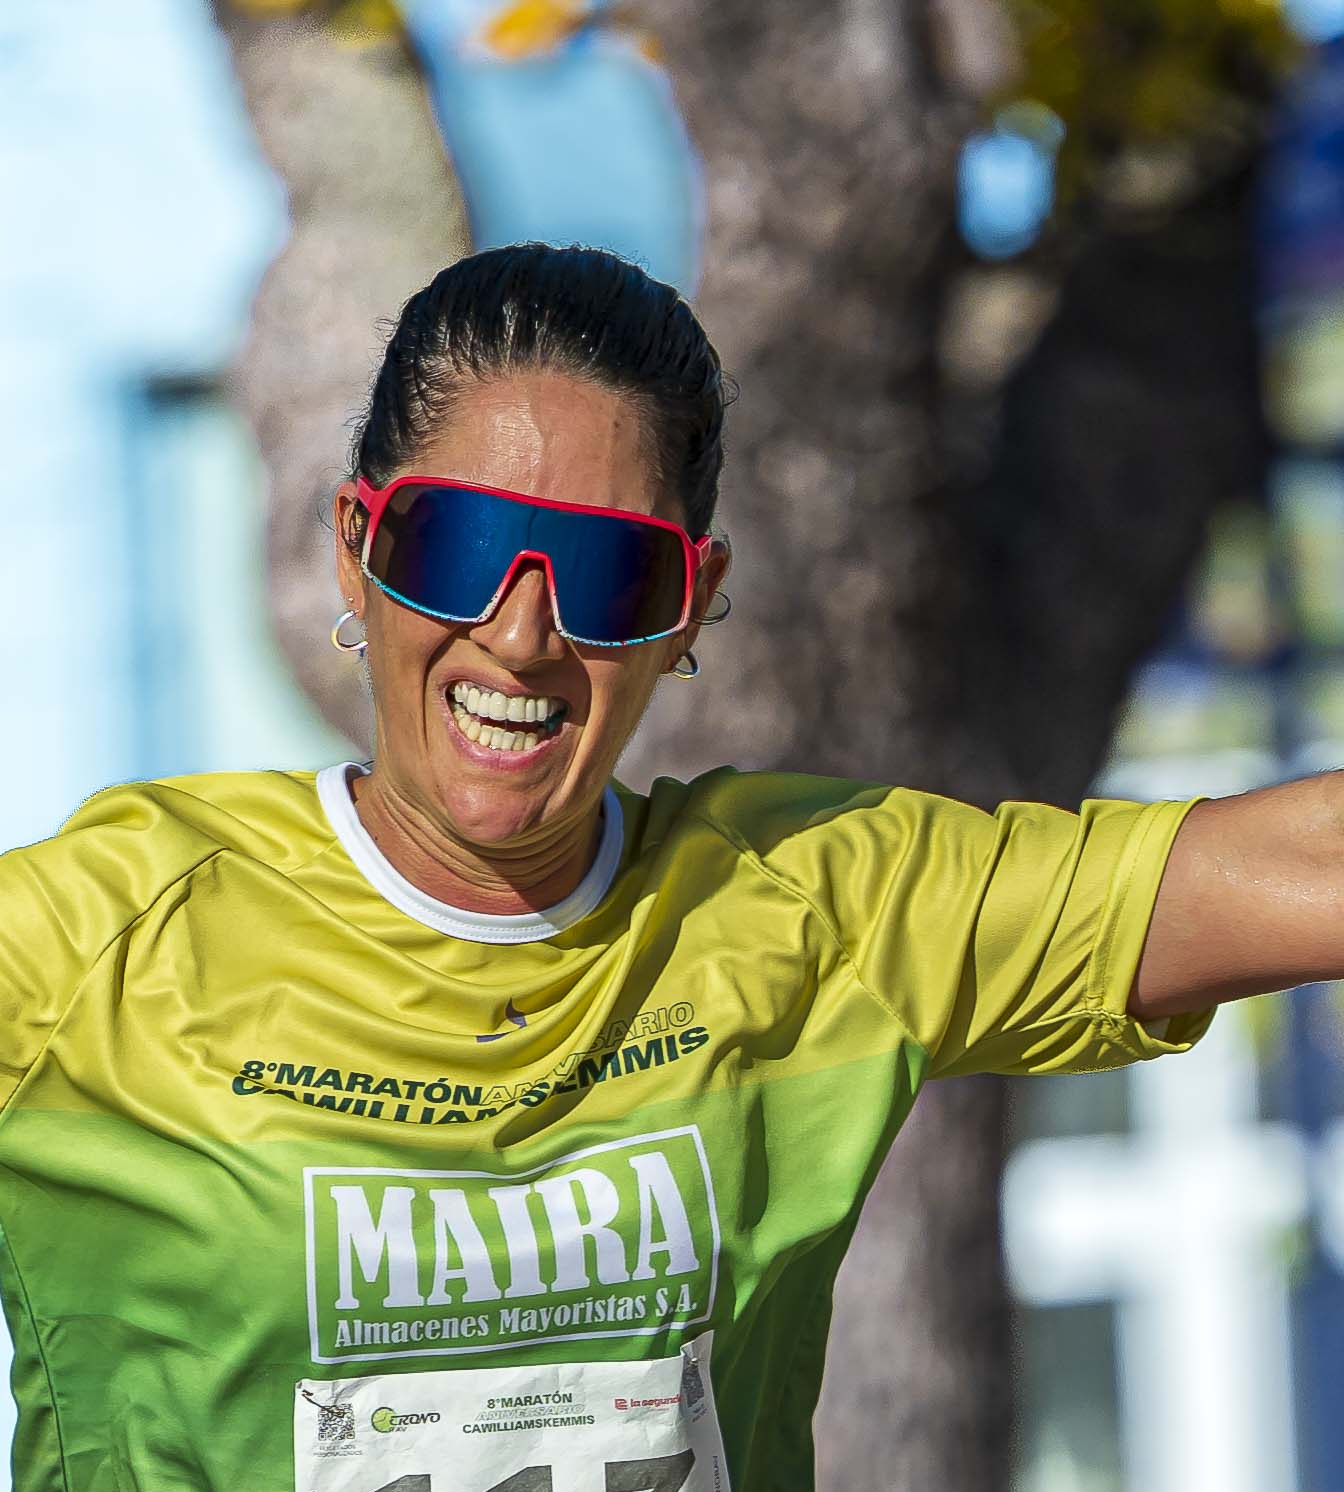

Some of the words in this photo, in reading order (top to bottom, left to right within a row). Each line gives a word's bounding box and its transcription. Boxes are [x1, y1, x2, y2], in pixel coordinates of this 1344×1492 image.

[330, 1151, 700, 1310] MAIRA
[334, 1313, 490, 1349] Almacenes
[498, 1295, 647, 1335] Mayoristas
[655, 1284, 698, 1317] S.A.
[462, 1415, 596, 1434] CAWILLIAMSKEMMIS
